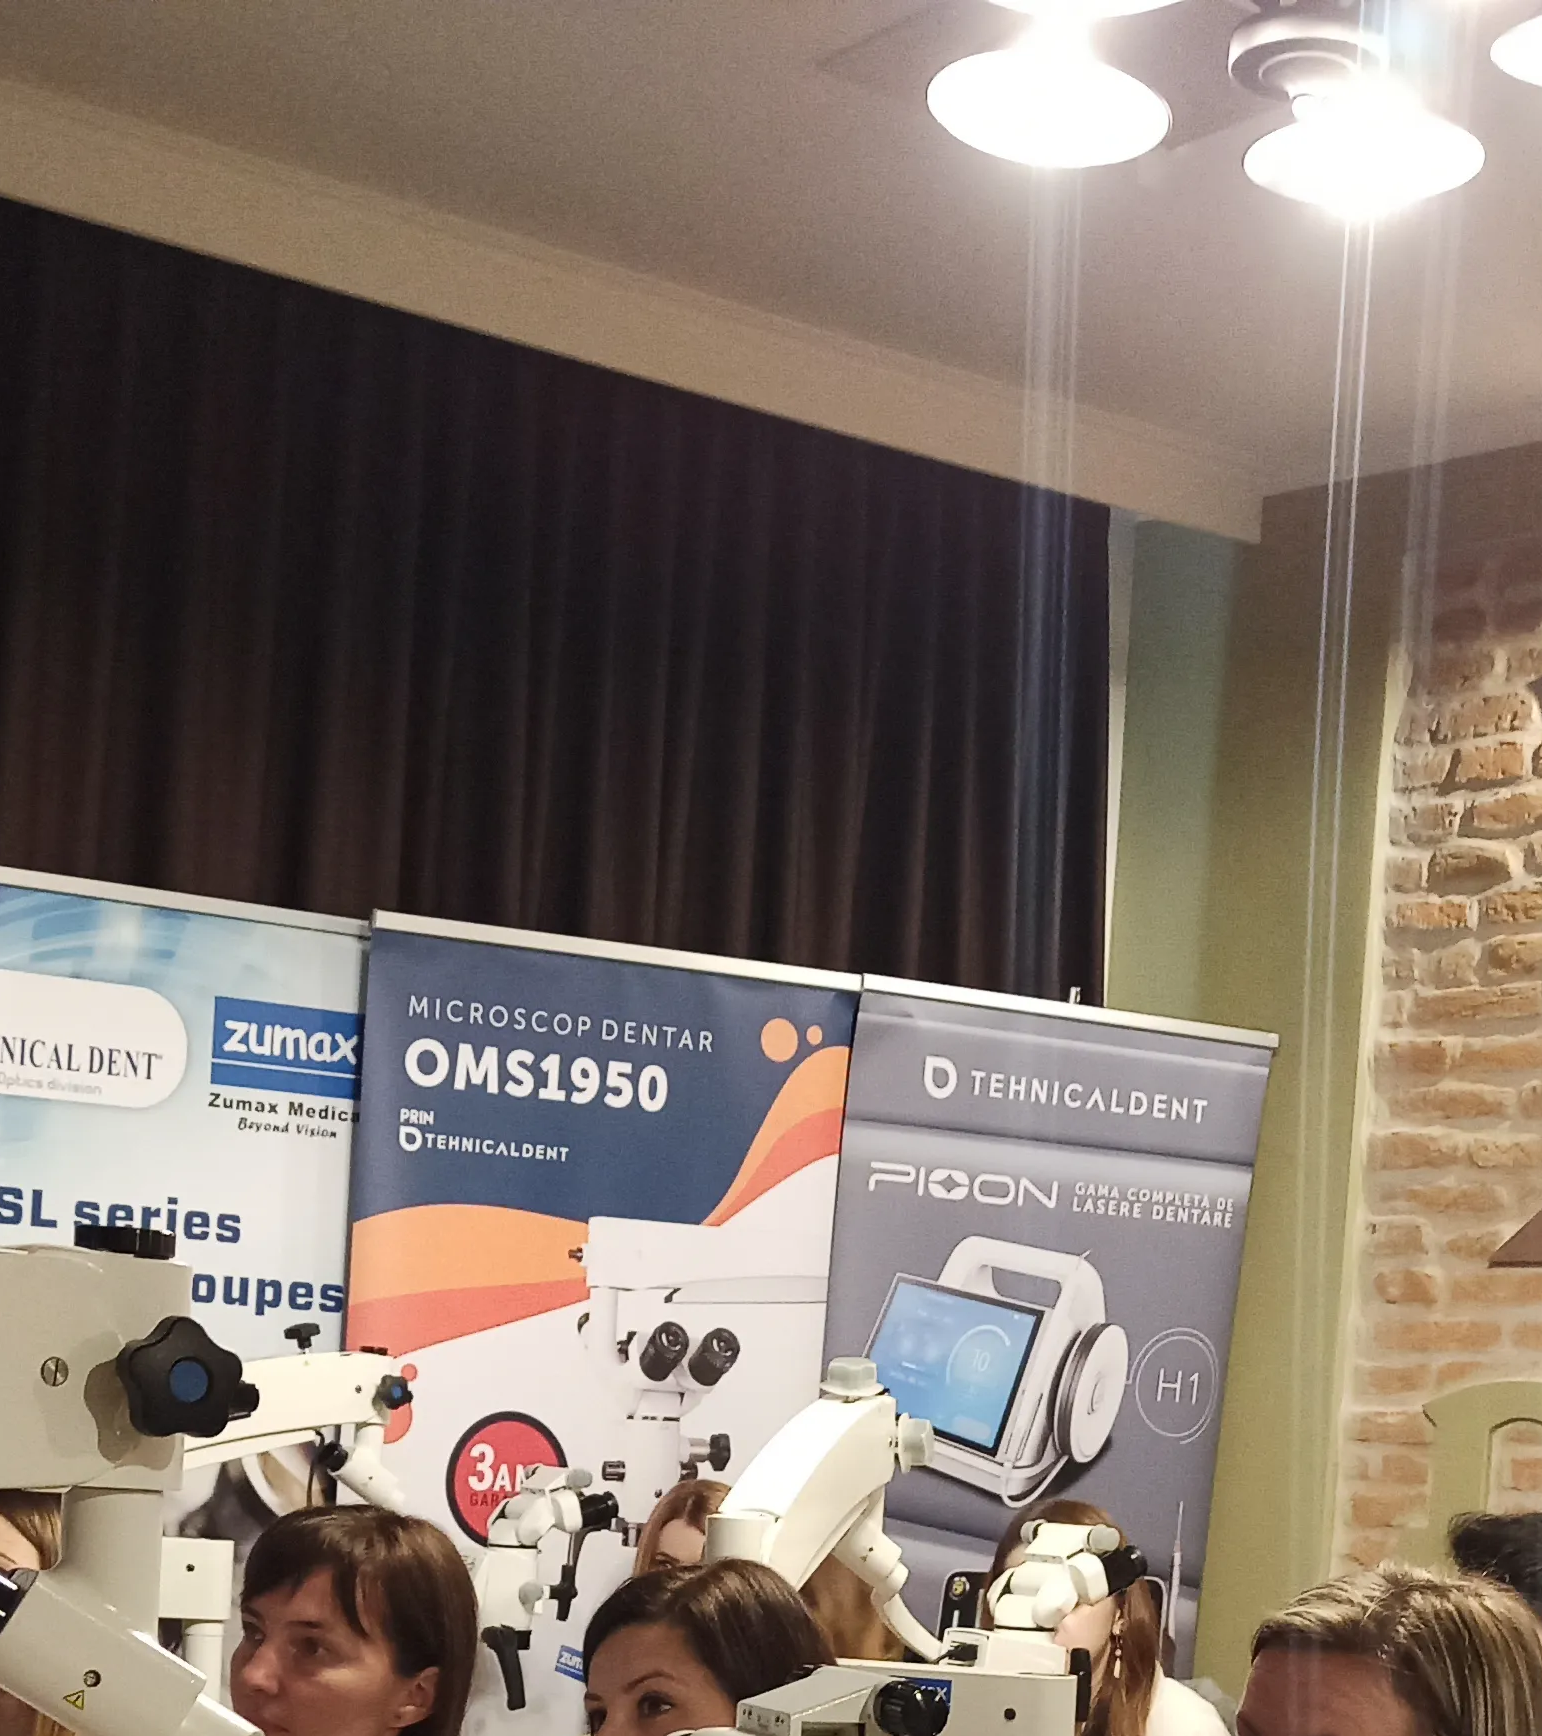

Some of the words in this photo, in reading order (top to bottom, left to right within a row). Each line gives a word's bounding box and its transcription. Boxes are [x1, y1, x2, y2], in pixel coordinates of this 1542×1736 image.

[222, 1018, 359, 1067] zumax
[407, 994, 593, 1039] MICROSCOP
[601, 1017, 715, 1054] DENTAR
[403, 1037, 669, 1114] OMS1950
[207, 1091, 280, 1116] Zumax
[399, 1107, 435, 1125] PRIN
[970, 1069, 1209, 1125] TEHNICALDENT
[237, 1115, 292, 1135] Beyond
[295, 1121, 338, 1140] Vision
[424, 1131, 570, 1163] TEHNICALDENT
[1071, 1195, 1143, 1220] LASERE
[1151, 1204, 1233, 1229] DENTARE
[1074, 1181, 1120, 1200] GAMA
[1216, 1196, 1235, 1213] DE
[73, 1196, 242, 1244] series
[192, 1272, 346, 1317] oupes
[1156, 1367, 1200, 1406] H1
